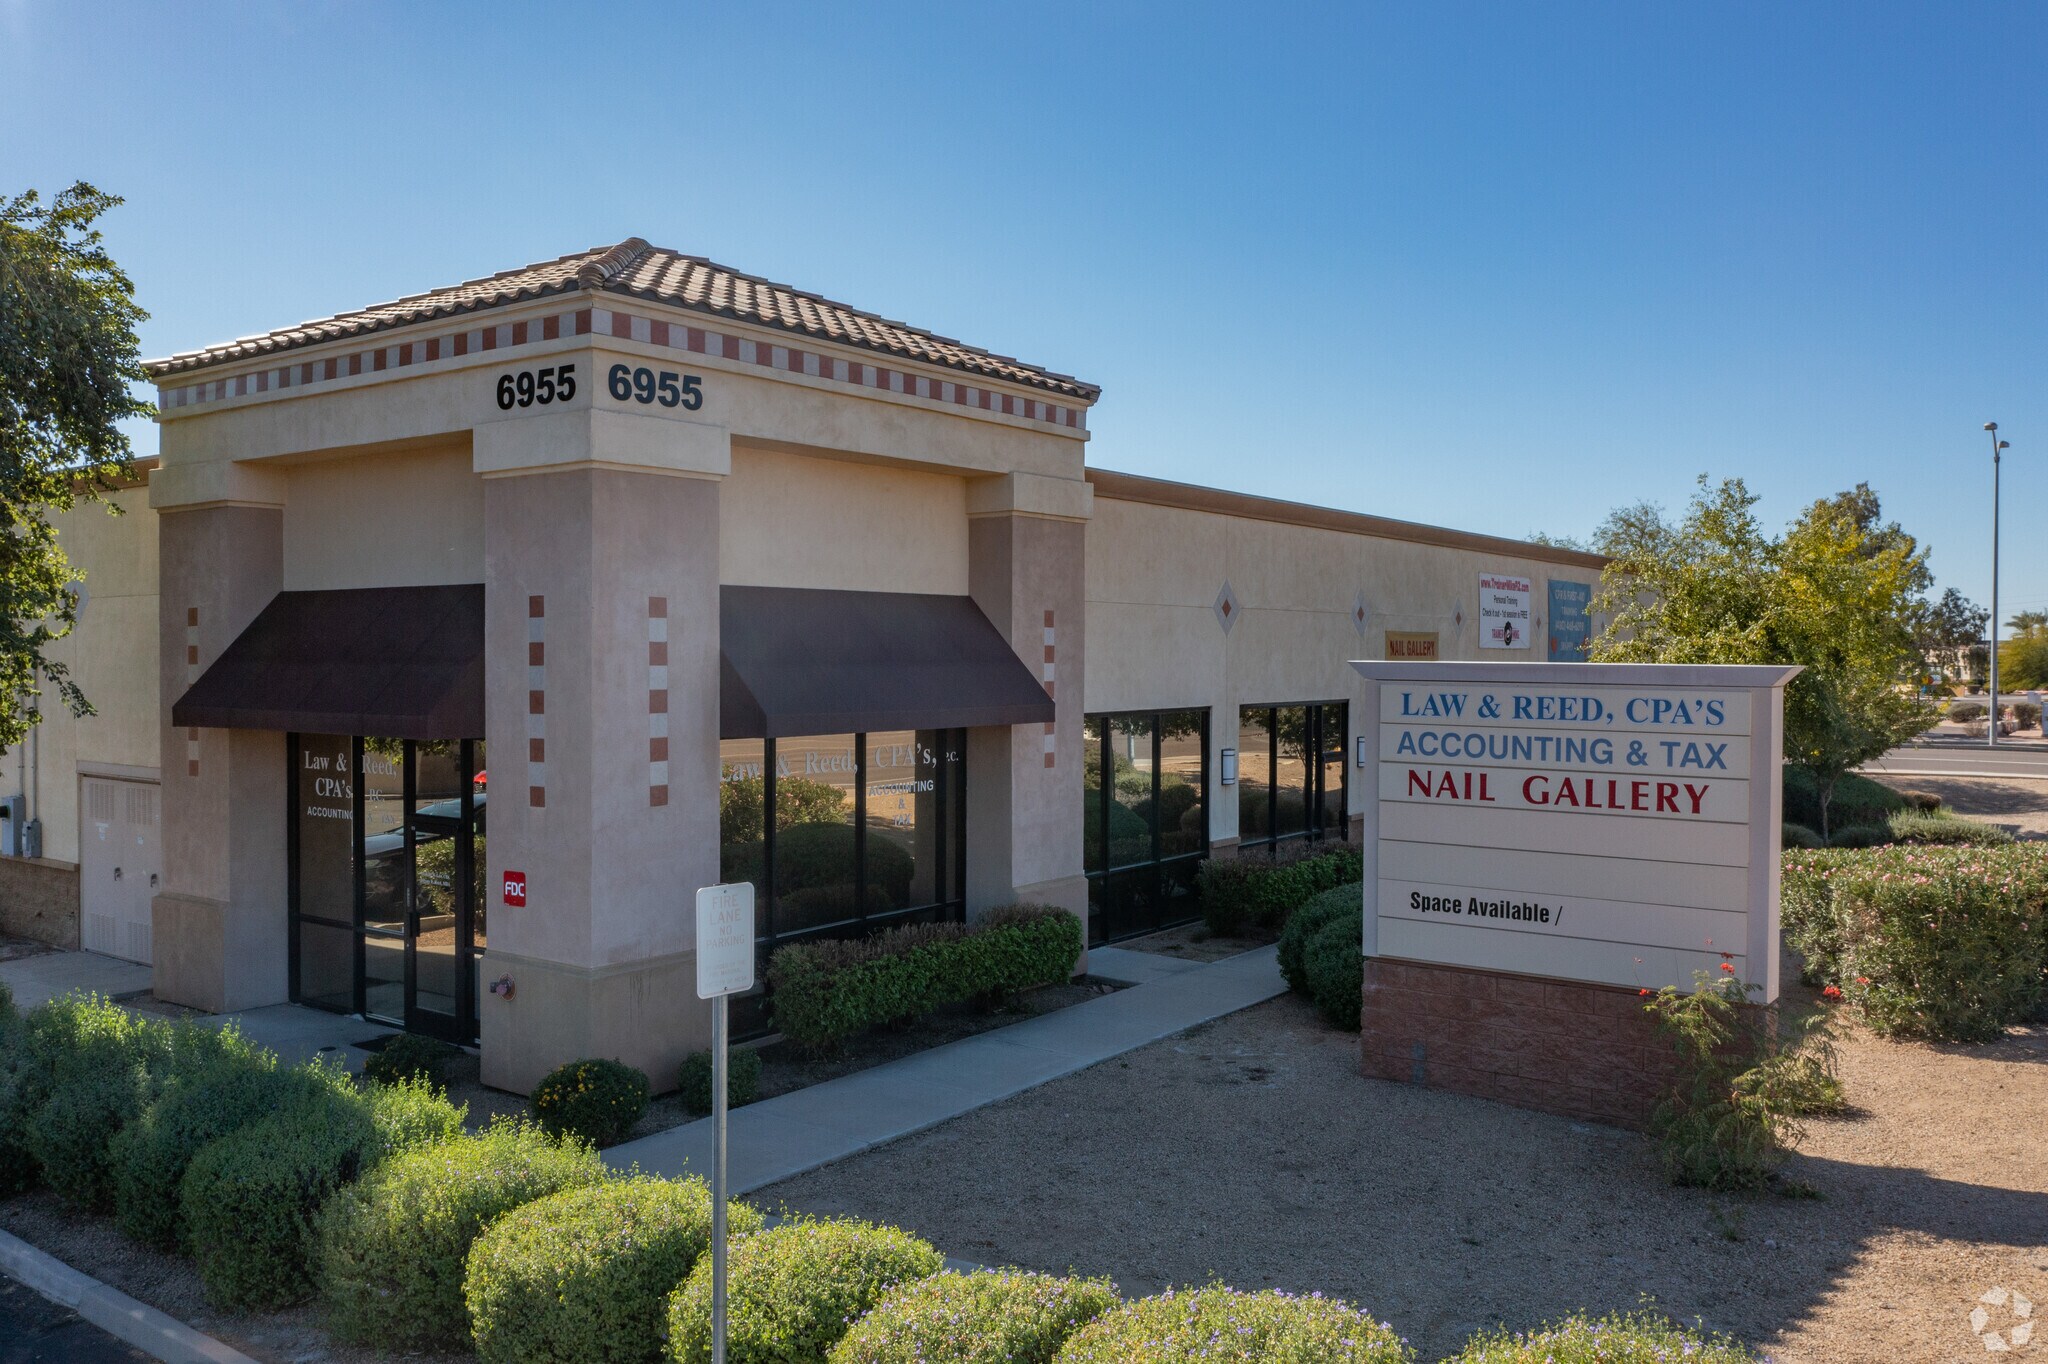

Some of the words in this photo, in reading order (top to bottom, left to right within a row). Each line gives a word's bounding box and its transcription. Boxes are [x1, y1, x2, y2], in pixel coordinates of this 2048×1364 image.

[497, 364, 576, 410] 6955
[608, 364, 703, 411] 6955
[1493, 595, 1506, 604] Personal
[1506, 596, 1518, 607] Training
[1390, 640, 1405, 656] NAIL
[1406, 640, 1435, 656] GALLERY
[1401, 693, 1468, 717] LAW
[1478, 694, 1501, 718] &
[1512, 695, 1614, 725] REED,
[1625, 698, 1725, 726] CPA'S
[1397, 731, 1614, 764] ACCOUNTING
[1626, 740, 1648, 766] &
[1660, 741, 1728, 770] TAX
[304, 751, 329, 770] Law
[336, 753, 347, 772] &
[361, 755, 397, 780] Reed,
[719, 760, 759, 782] Law
[776, 752, 791, 776] &
[805, 750, 857, 775] Reed,
[874, 742, 937, 769] CPA's,
[869, 780, 934, 796] ACCOUNTING
[1408, 769, 1495, 801] NAIL
[1522, 775, 1710, 814] GALLERY
[899, 798, 905, 809] &
[893, 813, 912, 826] TAX
[505, 881, 525, 897] FDC
[712, 894, 739, 909] FIRE
[1410, 892, 1462, 914] Space
[1468, 898, 1549, 923] Available
[709, 908, 743, 925] LANE
[719, 925, 732, 936] NO
[705, 934, 745, 950] PARKING
